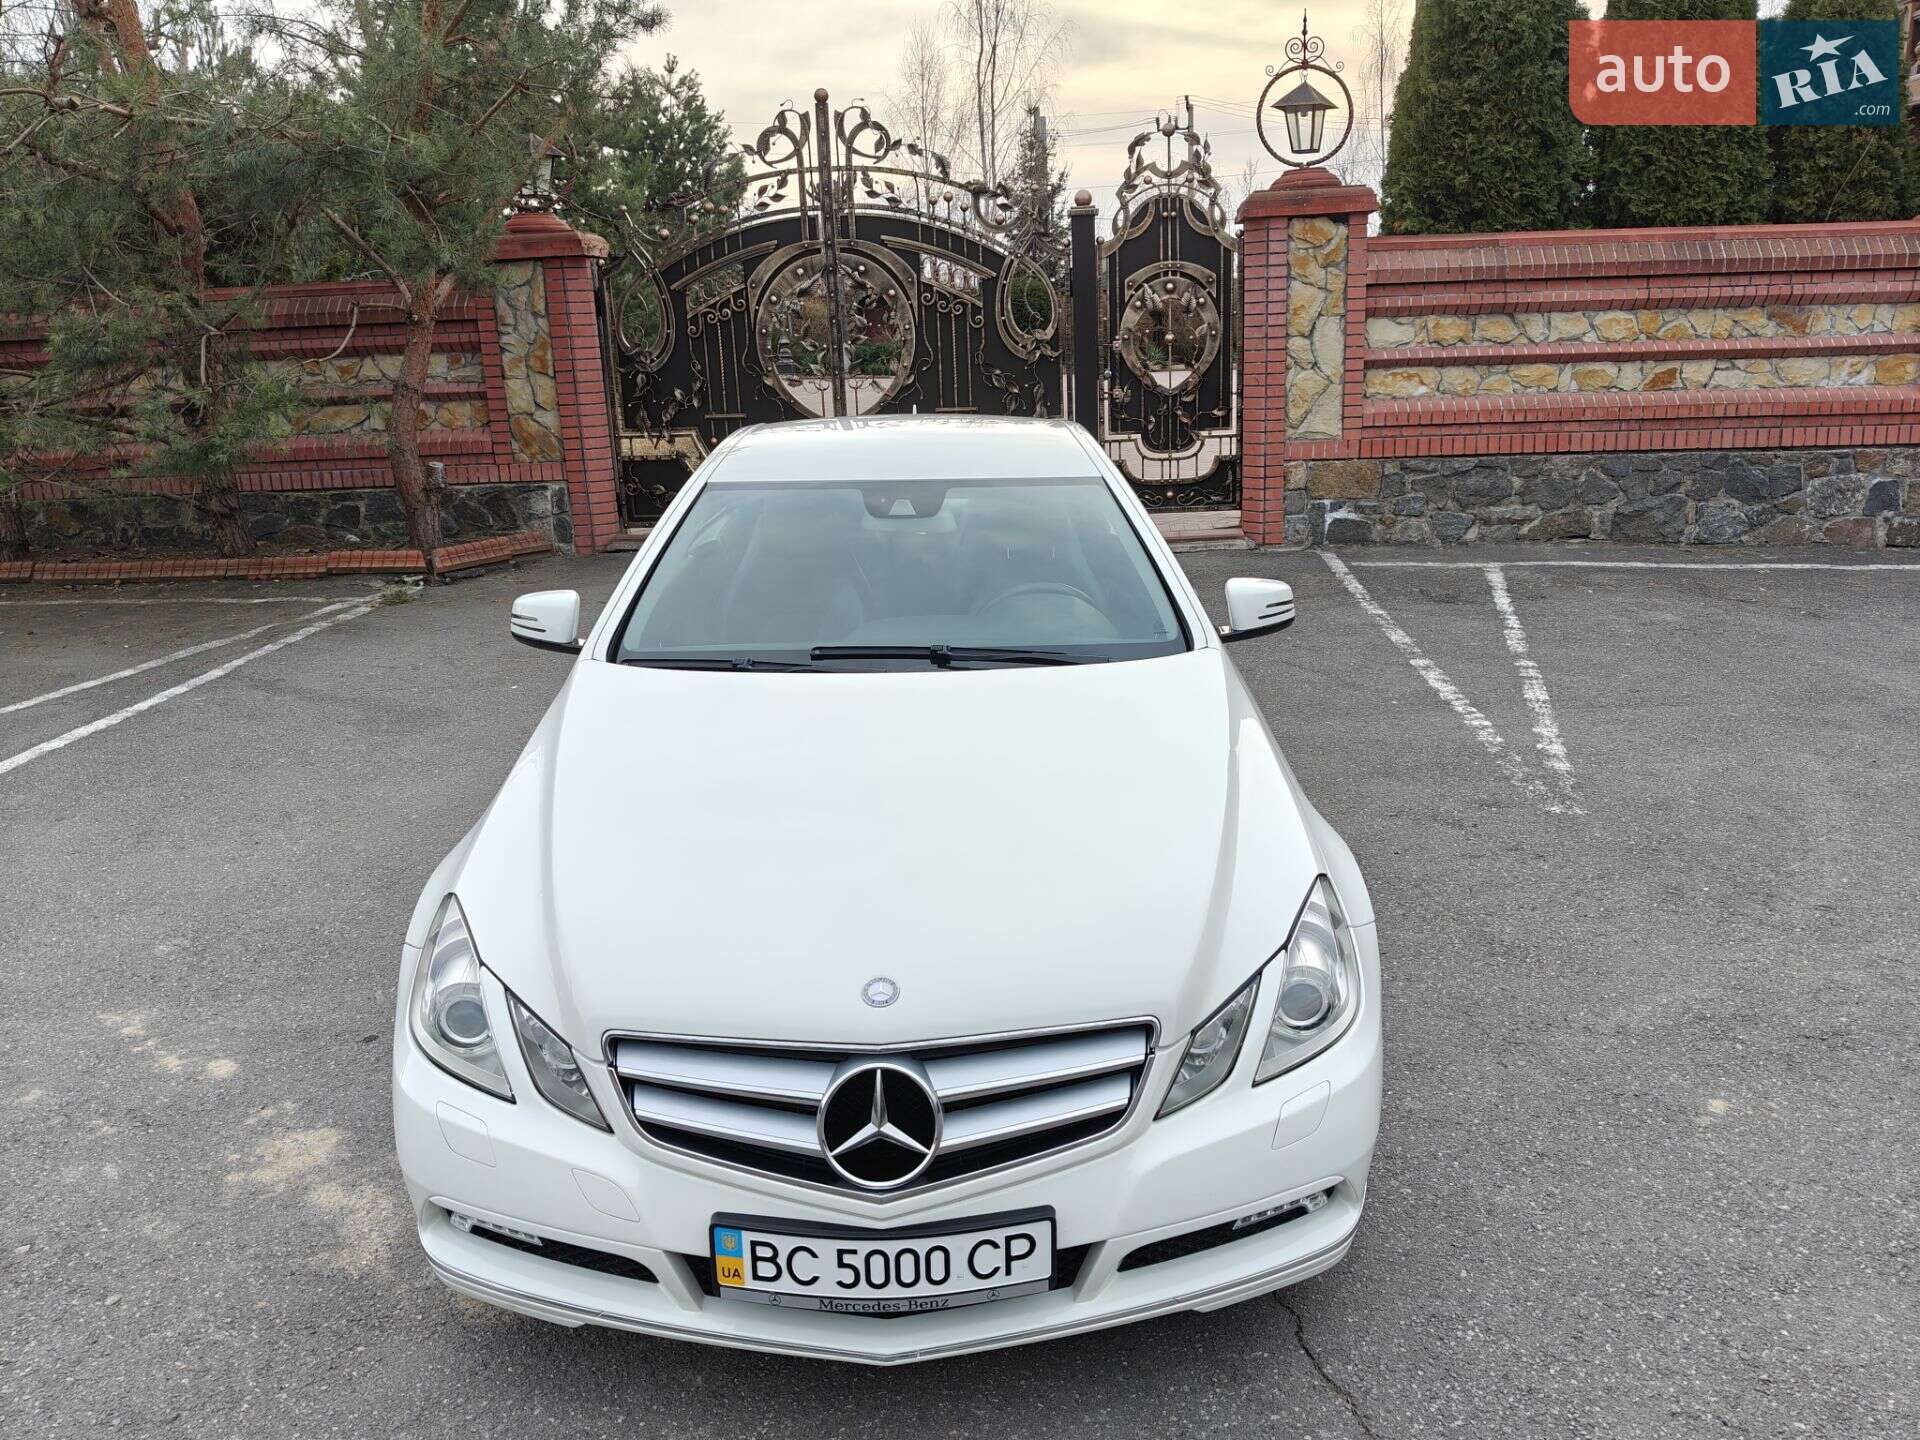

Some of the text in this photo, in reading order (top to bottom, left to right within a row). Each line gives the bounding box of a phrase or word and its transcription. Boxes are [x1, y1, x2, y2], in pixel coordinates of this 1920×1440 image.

[750, 1232, 1037, 1290] BC 5000 CP
[721, 1266, 742, 1280] UA
[819, 1297, 949, 1312] Mercedes-Benz
